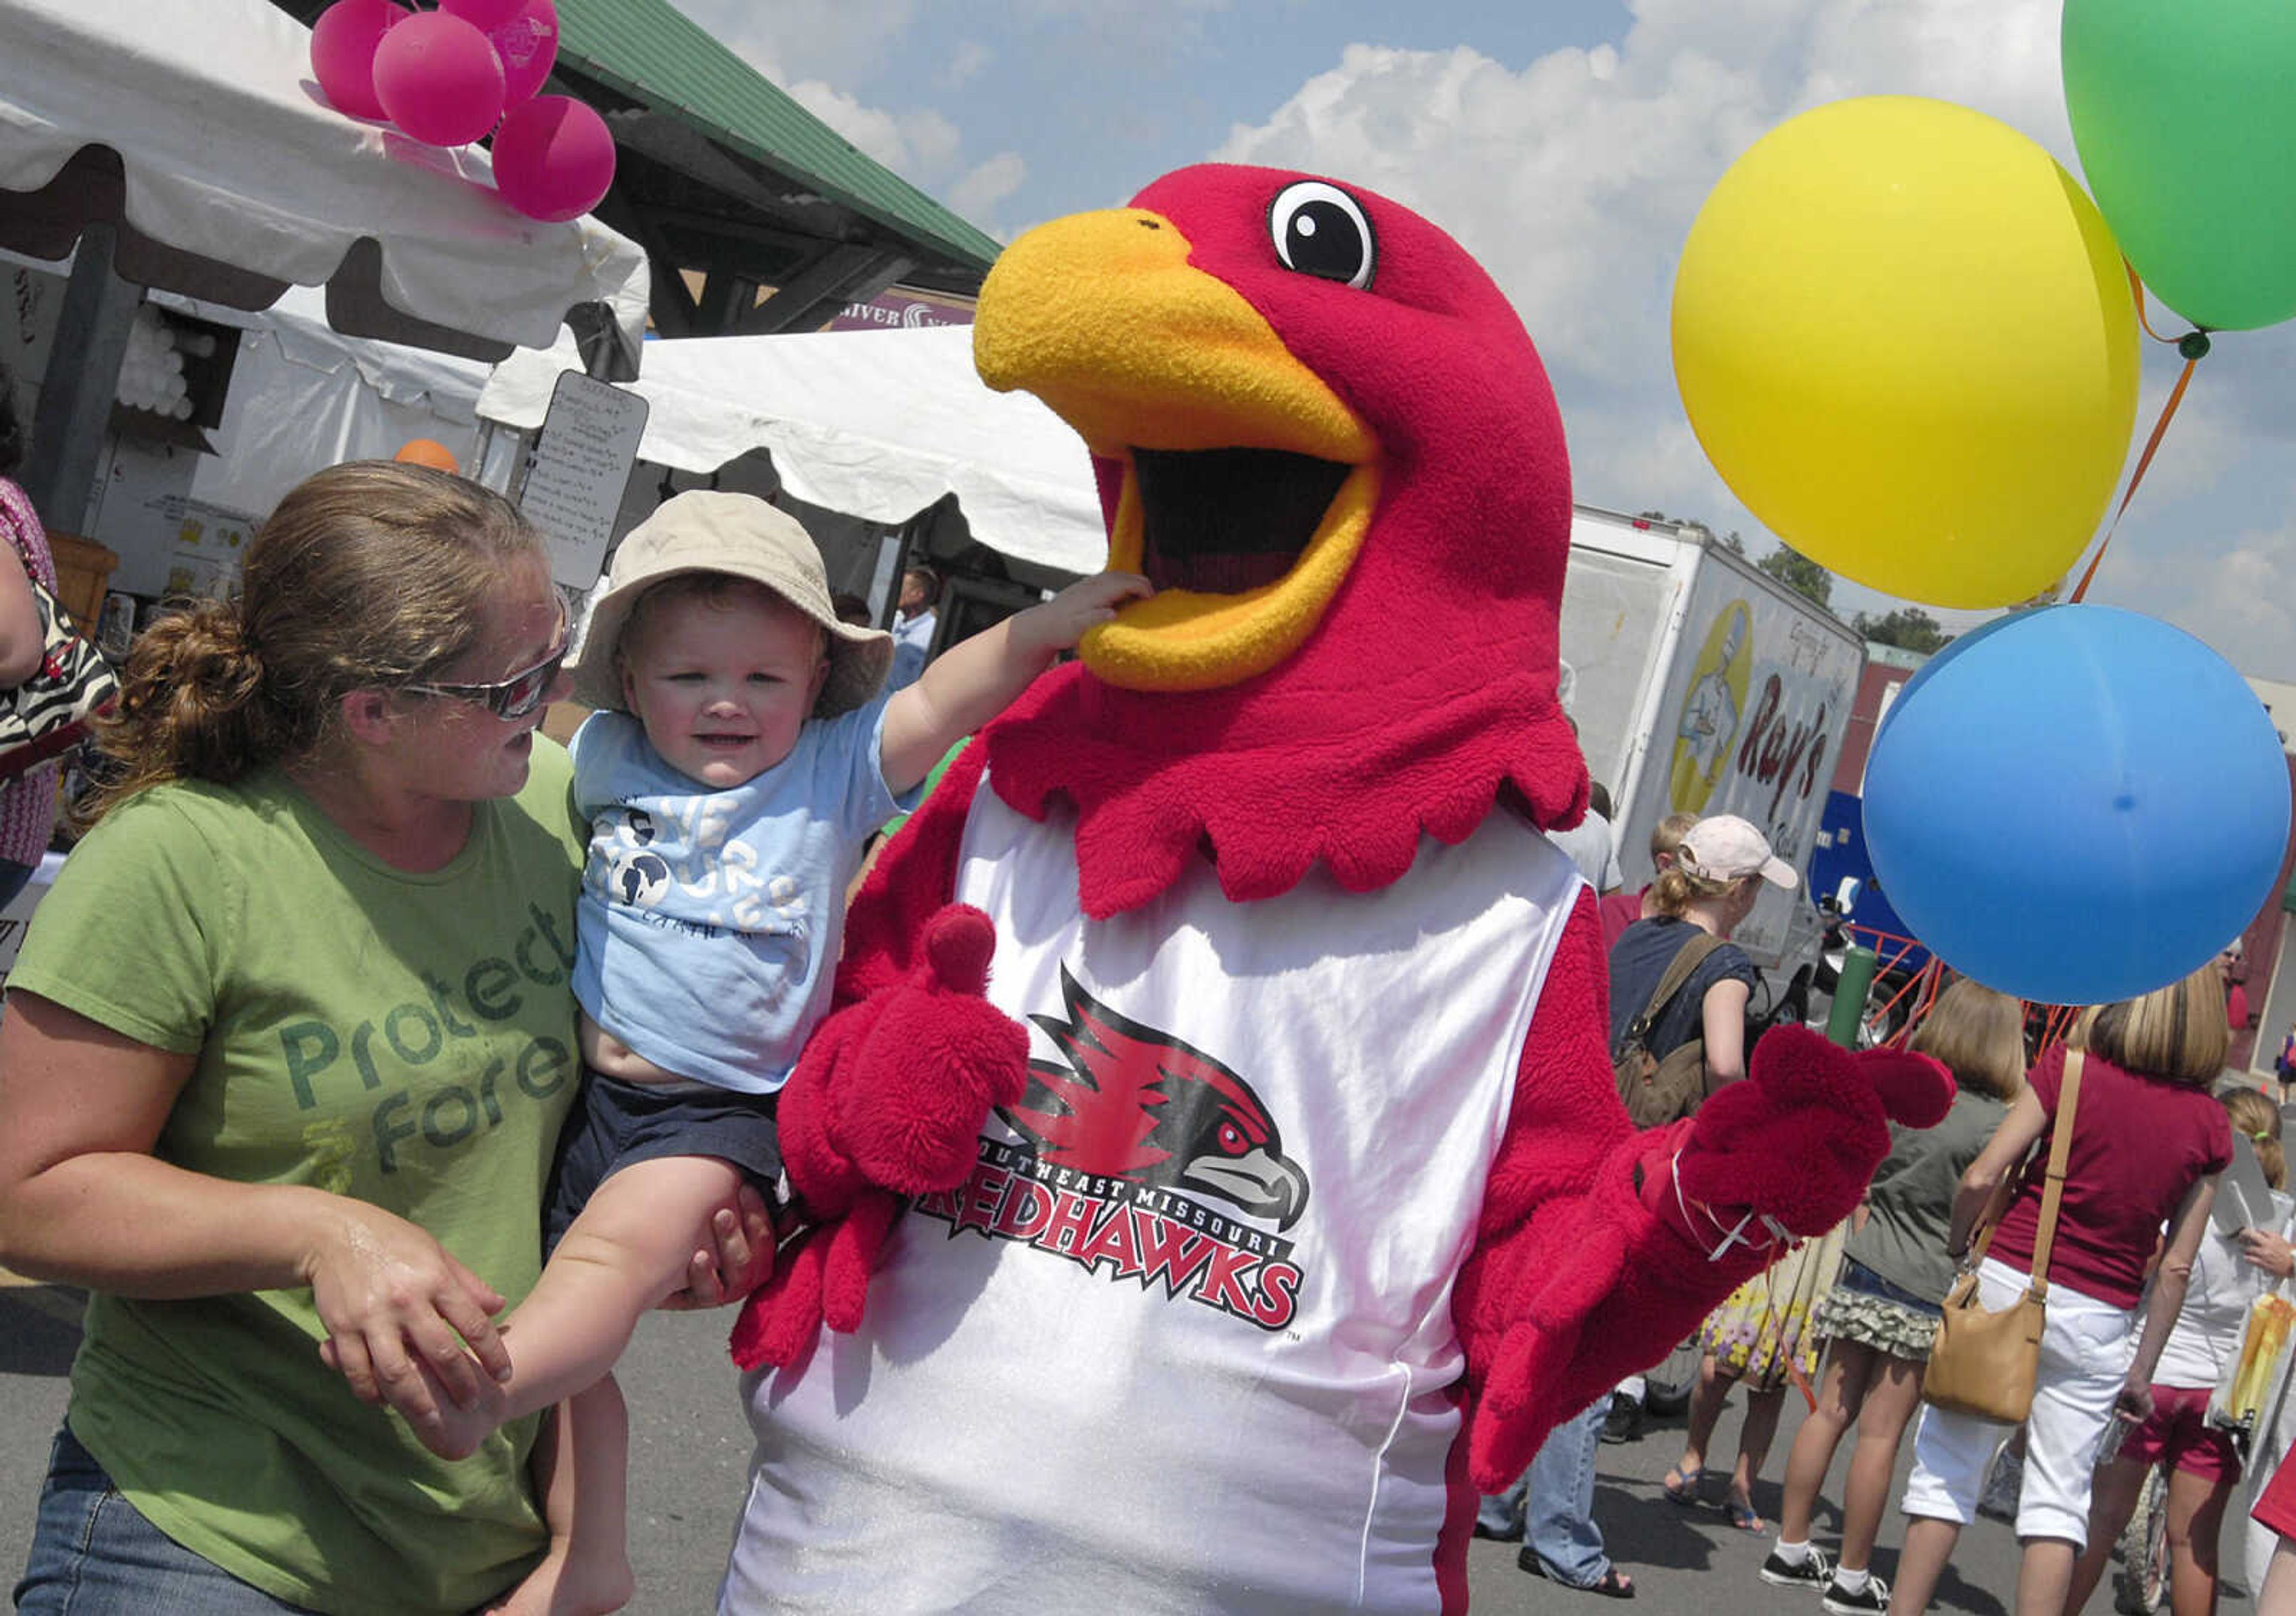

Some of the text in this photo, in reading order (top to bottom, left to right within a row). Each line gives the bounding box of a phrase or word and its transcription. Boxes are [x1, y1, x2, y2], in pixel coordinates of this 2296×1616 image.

[1737, 673, 1827, 823] Ray's
[279, 901, 577, 1111] Protect
[979, 1141, 1280, 1255] OUTHEAST MISSOURI
